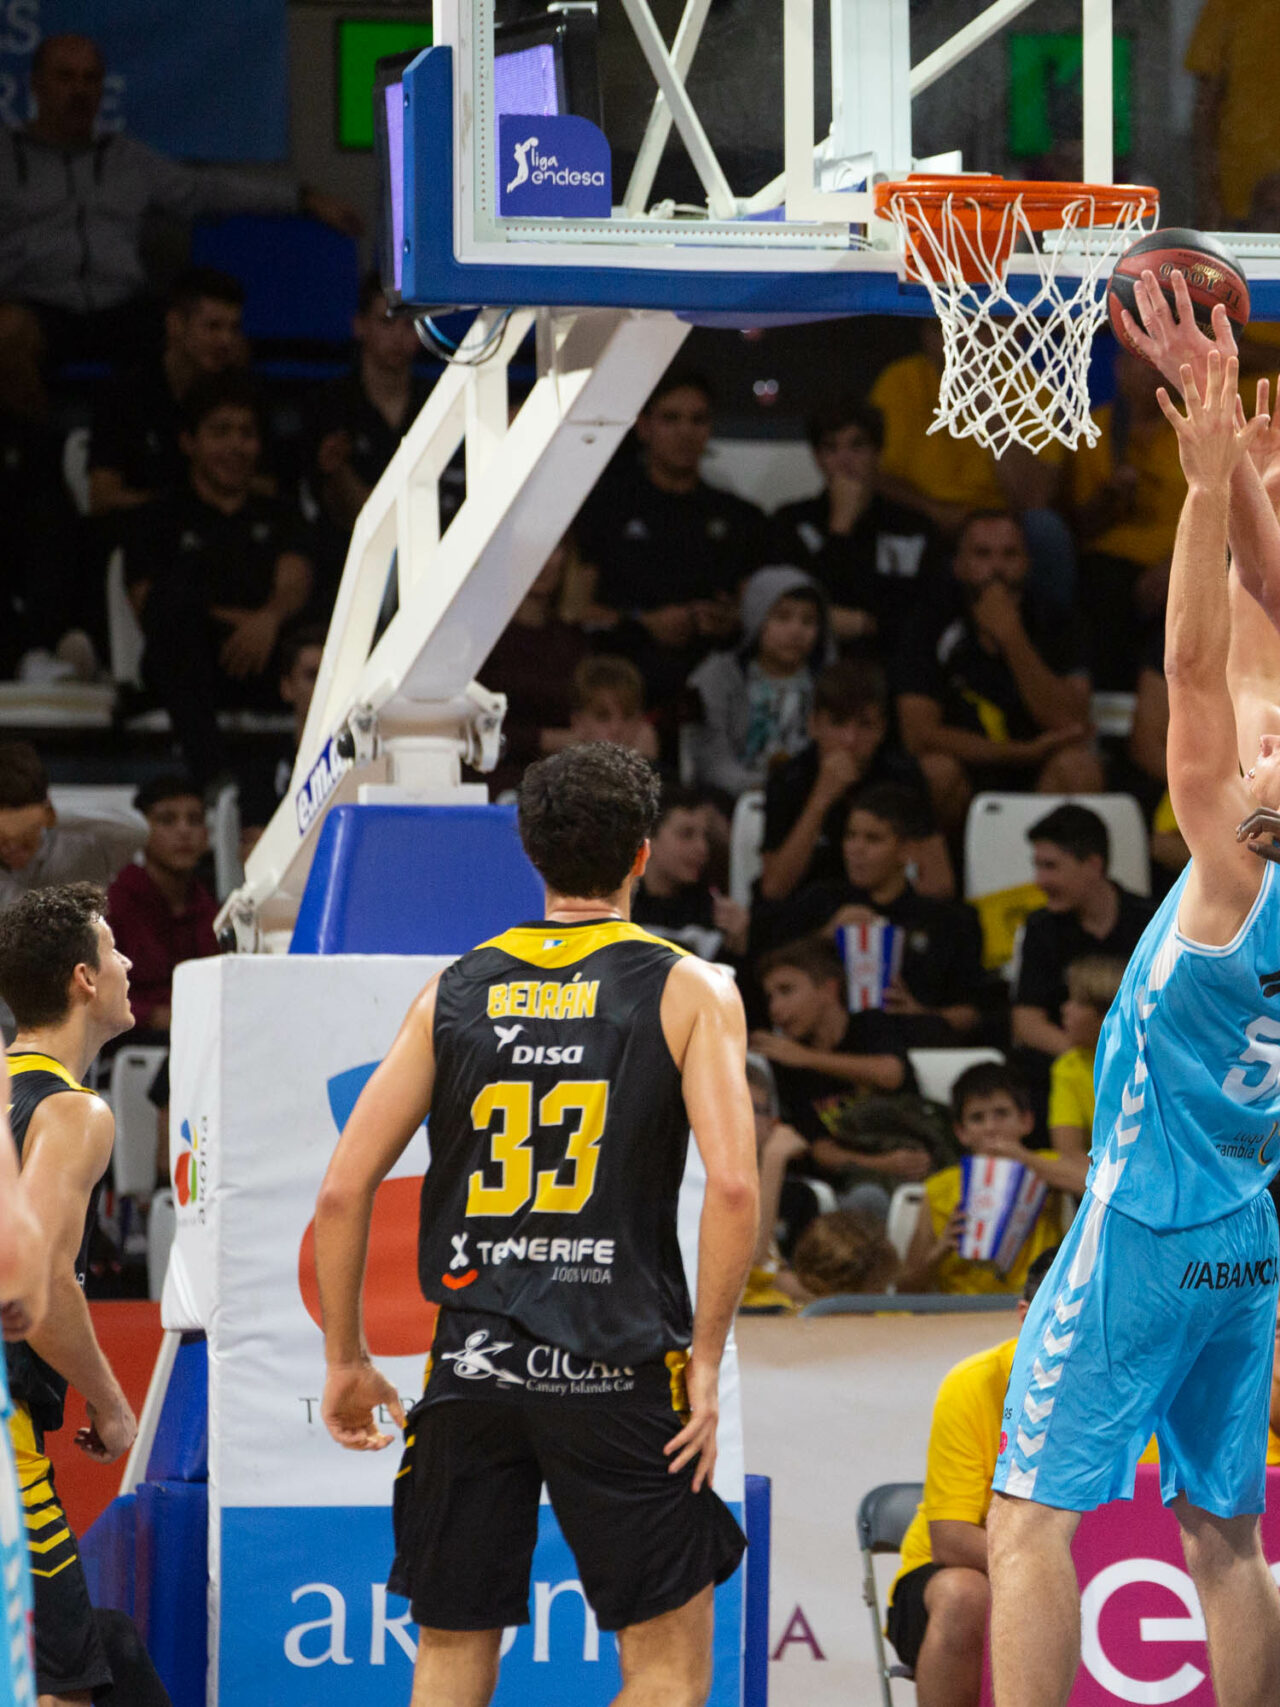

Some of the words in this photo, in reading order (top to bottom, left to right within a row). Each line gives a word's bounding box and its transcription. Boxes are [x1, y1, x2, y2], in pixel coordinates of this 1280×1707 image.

[531, 147, 558, 171] liga
[531, 167, 604, 187] endesa
[487, 972, 600, 1020] BEIRÁN
[465, 1080, 609, 1217] 33
[476, 1236, 615, 1265] TENERIFE
[525, 1378, 567, 1397] Canary
[570, 1380, 612, 1394] Islands
